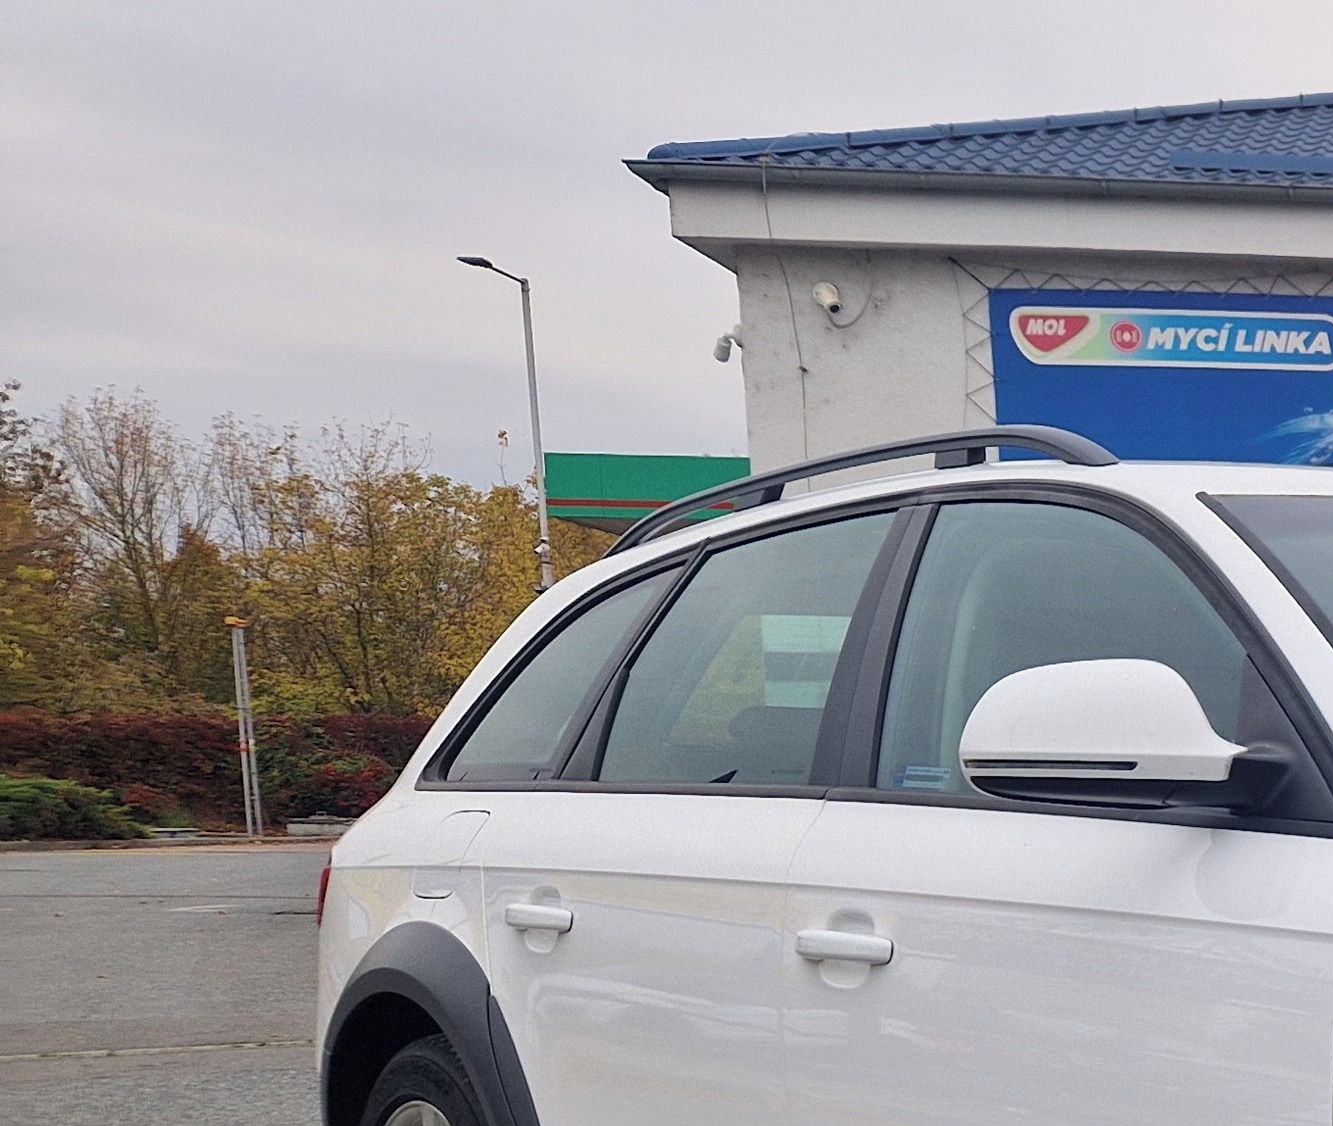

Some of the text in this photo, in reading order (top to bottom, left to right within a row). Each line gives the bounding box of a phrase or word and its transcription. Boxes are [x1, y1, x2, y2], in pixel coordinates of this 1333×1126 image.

[1026, 318, 1067, 336] MOL
[1147, 323, 1332, 354] MYCÍ LINKA
